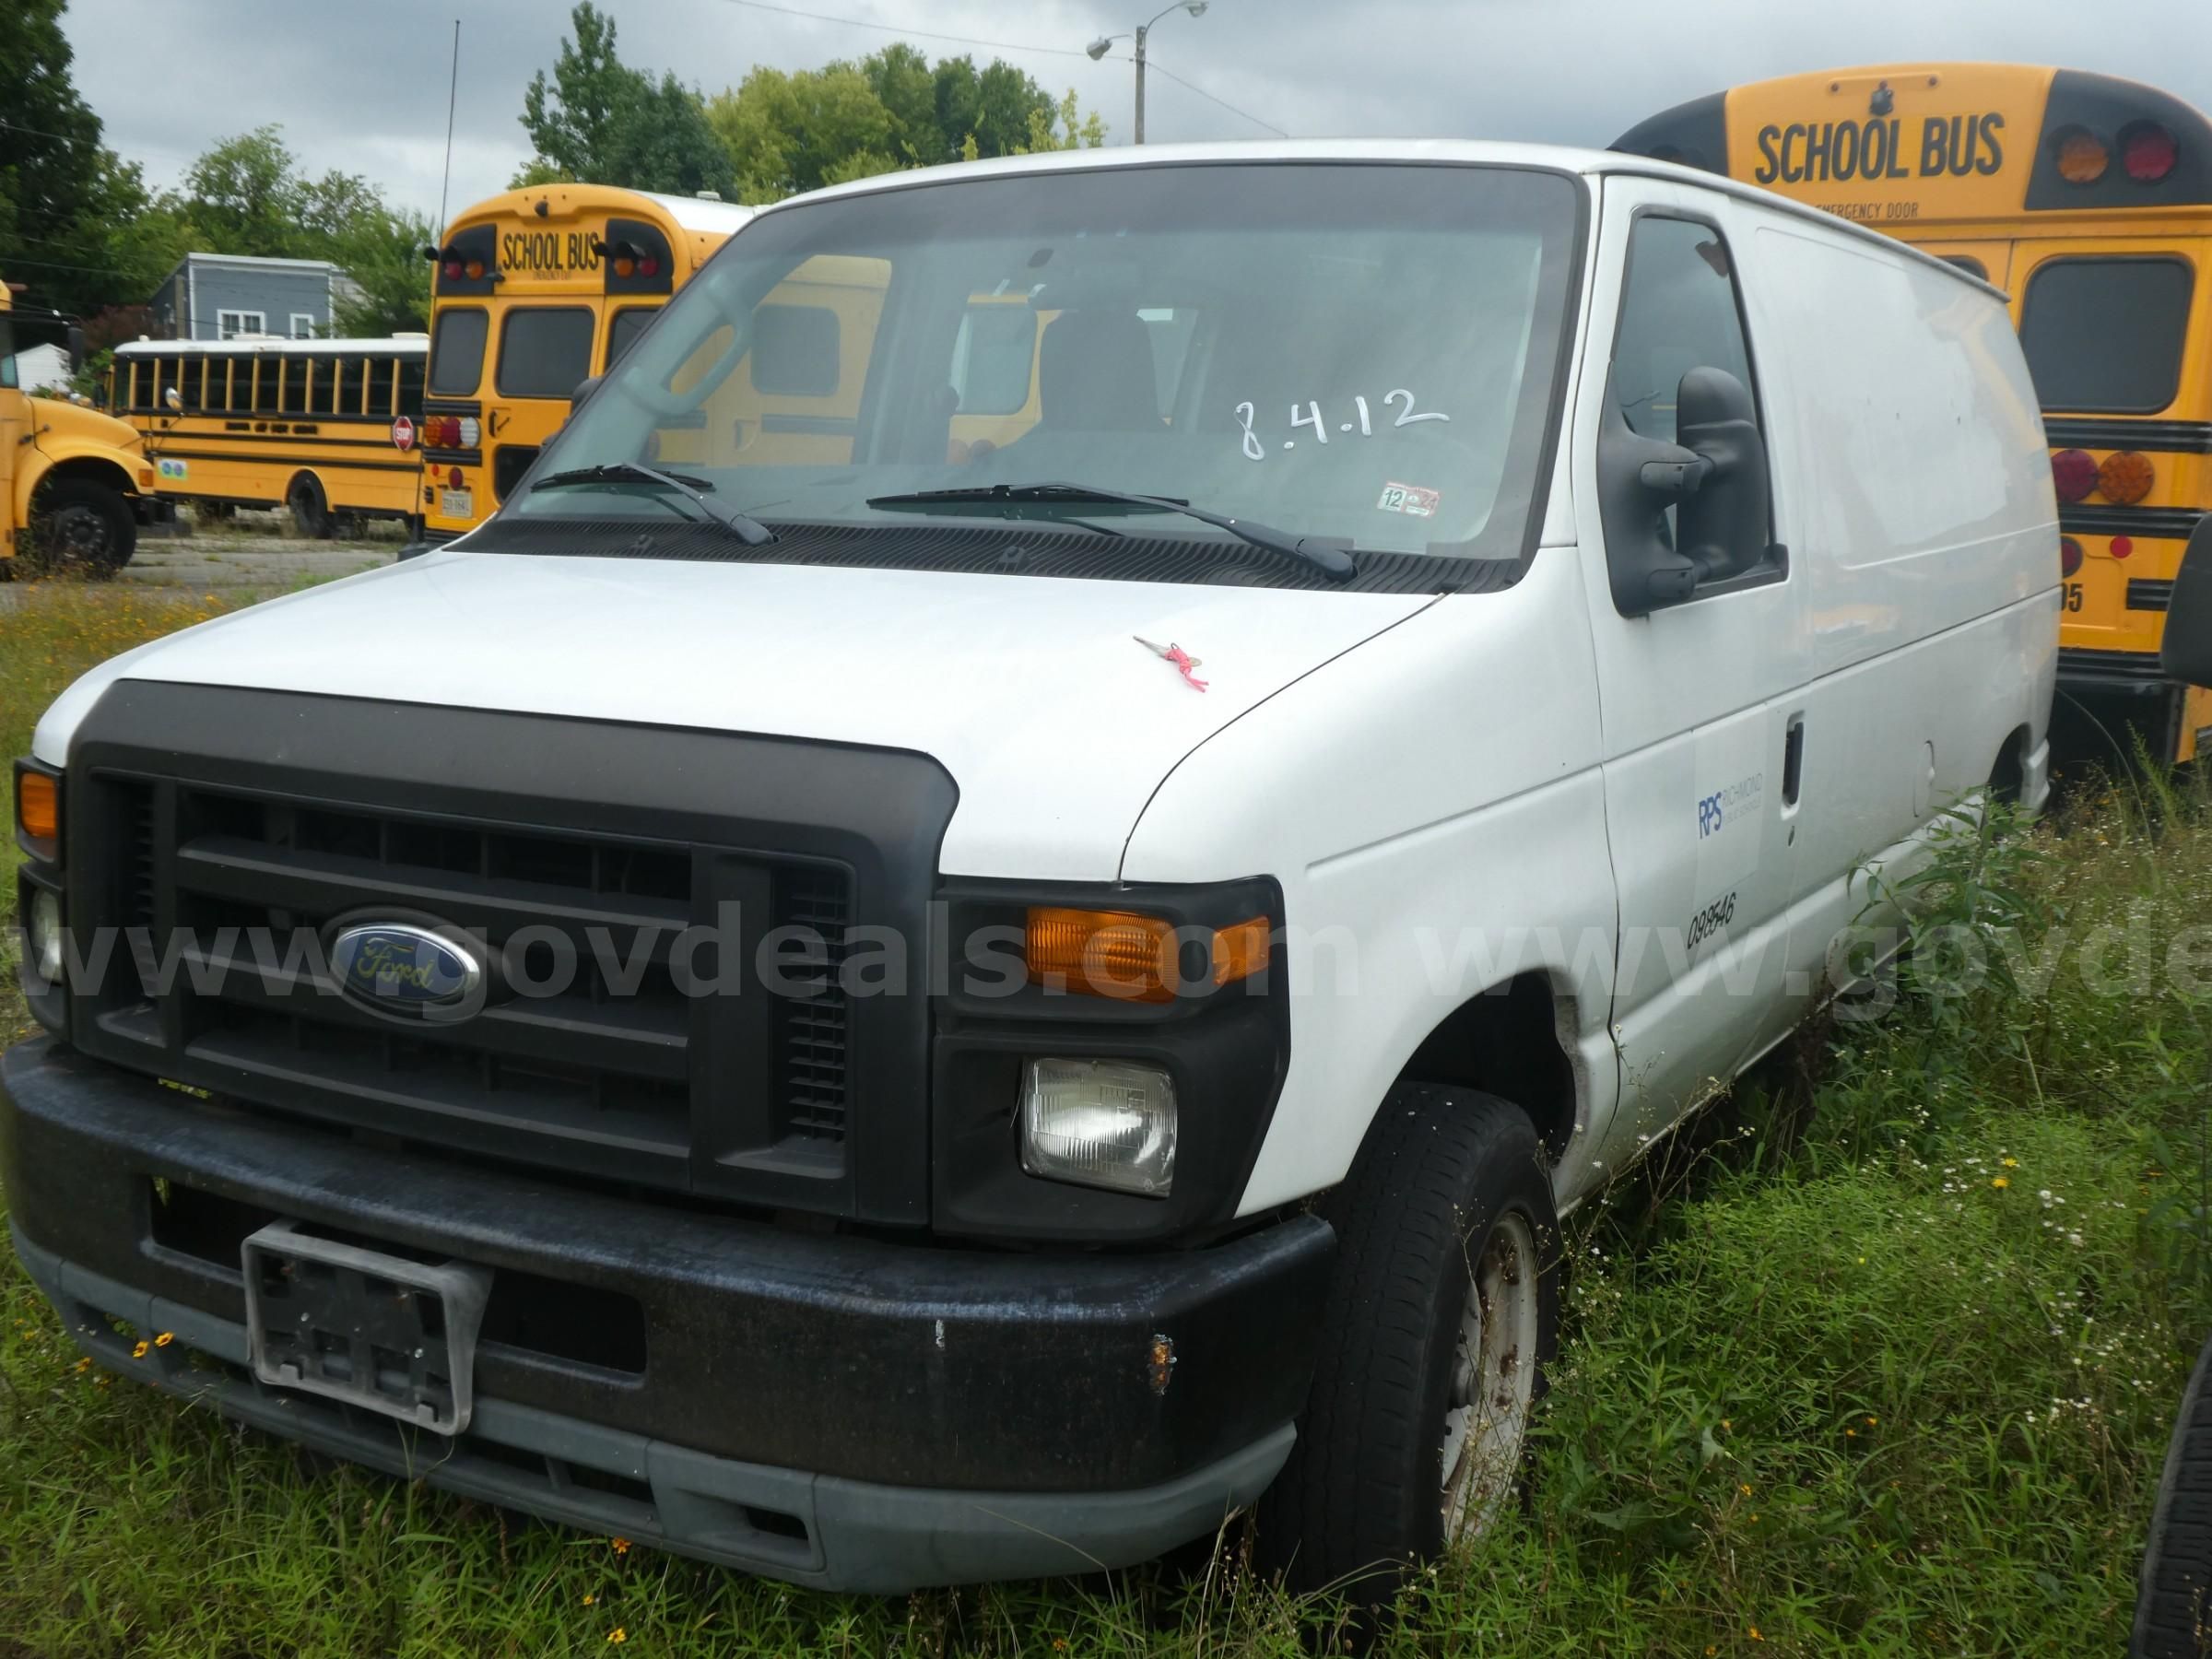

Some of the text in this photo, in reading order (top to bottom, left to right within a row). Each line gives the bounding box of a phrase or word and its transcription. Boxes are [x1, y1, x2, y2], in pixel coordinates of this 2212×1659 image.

[1755, 112, 2006, 184] SCHOOL BUS
[1887, 201, 1919, 219] DOOR
[502, 231, 599, 271] SCHOOL BUS
[395, 427, 411, 441] STOP
[1385, 489, 1403, 508] 12
[1699, 792, 1723, 840] RPS
[1687, 891, 1736, 950] 098546
[357, 936, 435, 989] Ford
